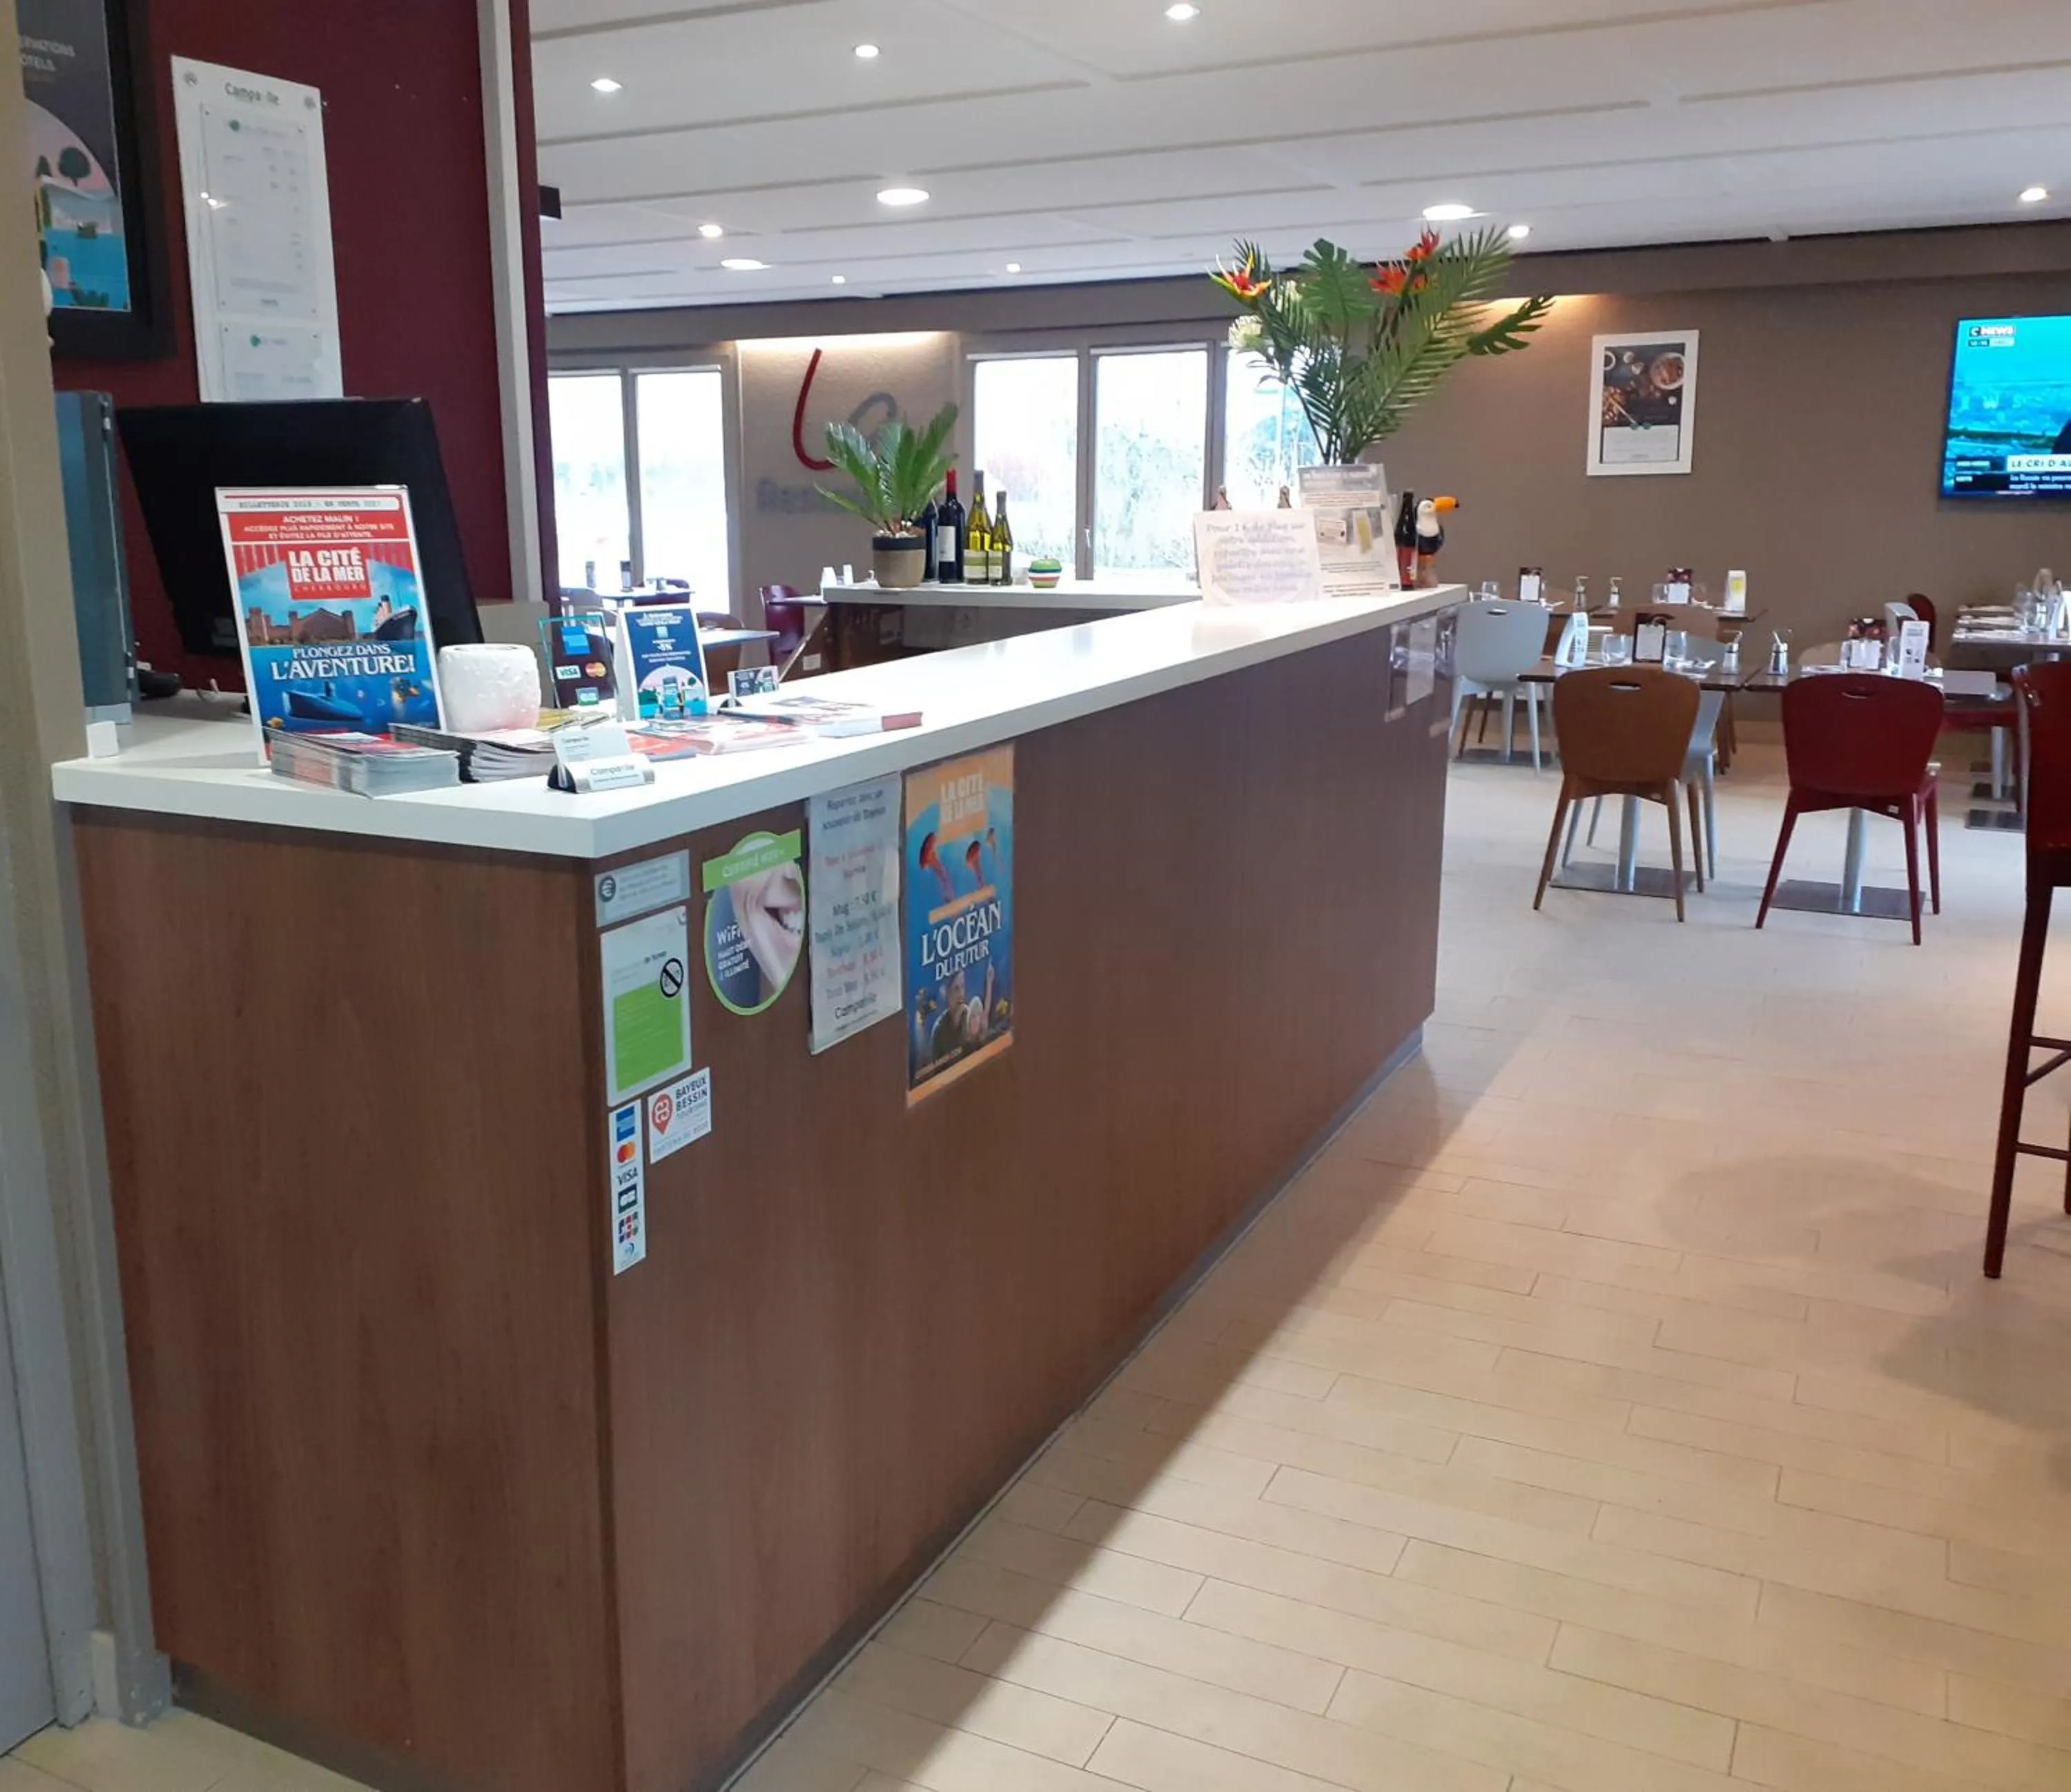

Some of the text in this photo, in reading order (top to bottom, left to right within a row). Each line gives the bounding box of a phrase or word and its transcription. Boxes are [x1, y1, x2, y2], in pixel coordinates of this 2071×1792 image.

[288, 546, 363, 567] LA CITÉ
[291, 565, 365, 583] DE LA MER
[292, 643, 391, 659] PLONGEZ DANS
[271, 654, 416, 681] L'AVENTURE!
[559, 667, 578, 677] VISA
[940, 771, 984, 803] LA CITÉ
[922, 900, 1002, 966] L'OCÉAN
[935, 939, 989, 981] DU FUTUR
[675, 1075, 707, 1100] BAYEUX
[676, 1089, 708, 1113] BESSIN
[616, 1166, 639, 1185] VISA
